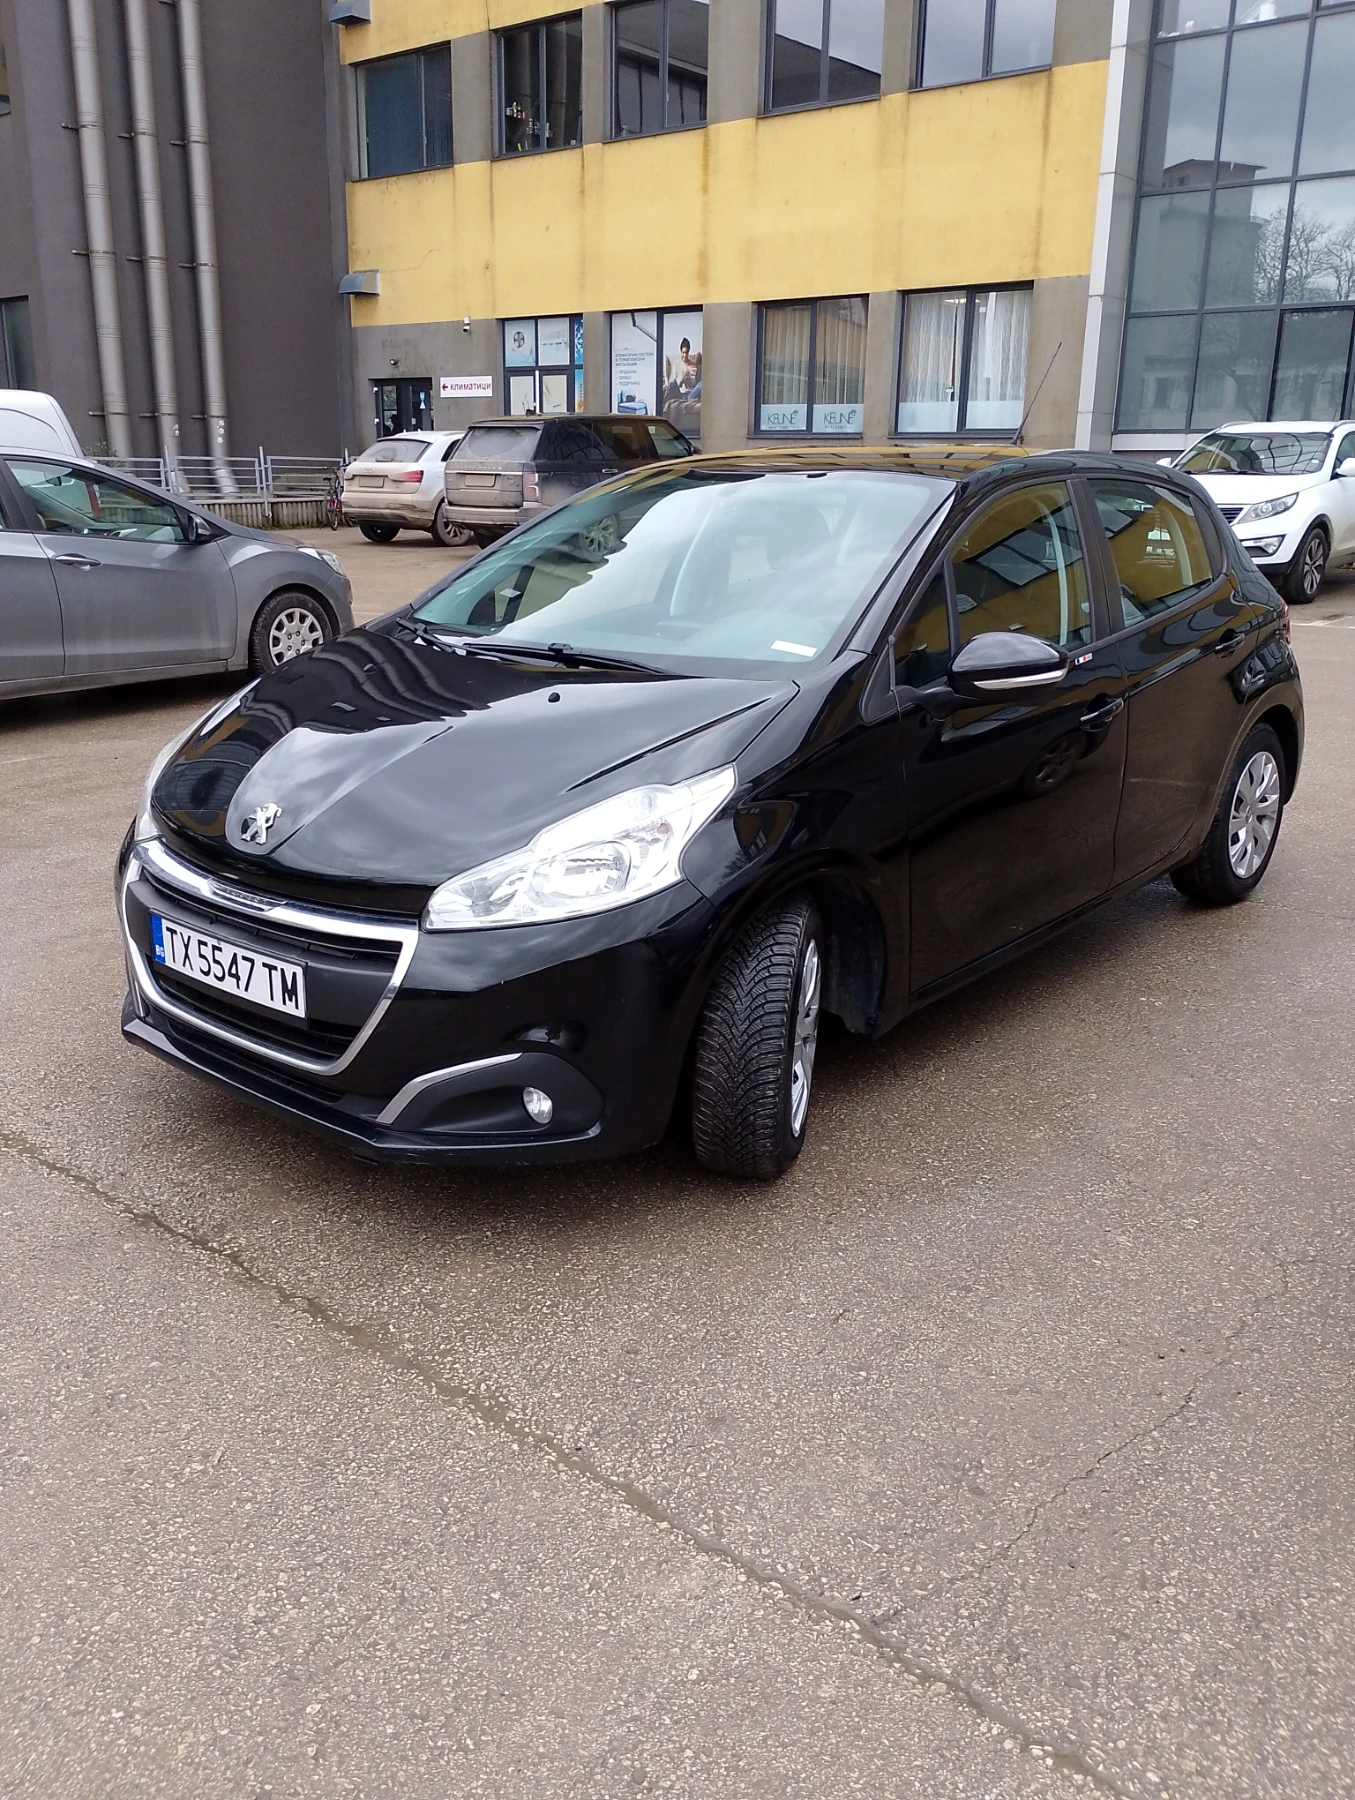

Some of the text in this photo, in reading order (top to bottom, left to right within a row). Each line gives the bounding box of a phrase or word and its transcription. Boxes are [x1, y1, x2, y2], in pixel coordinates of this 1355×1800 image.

[155, 944, 165, 958] BG
[165, 926, 299, 1010] TX 5547 TM
